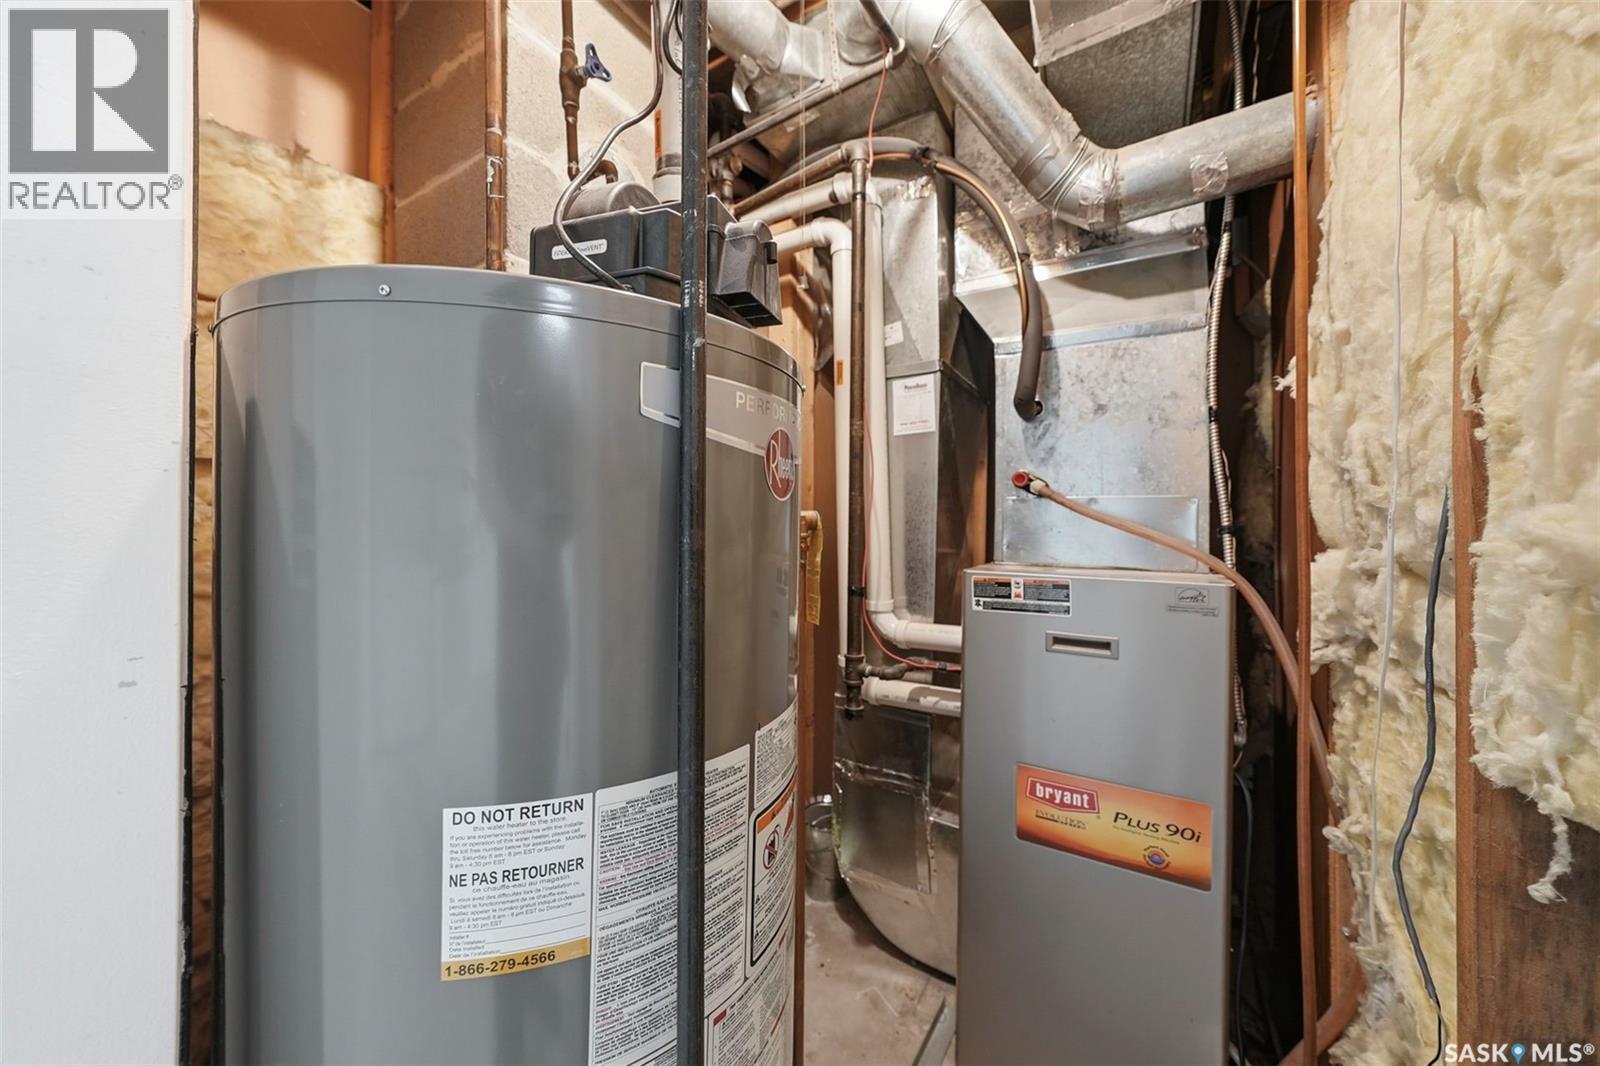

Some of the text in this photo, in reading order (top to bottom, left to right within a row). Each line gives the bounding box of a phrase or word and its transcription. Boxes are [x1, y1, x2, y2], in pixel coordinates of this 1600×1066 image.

[1036, 782, 1090, 808] bryant
[452, 811, 476, 826] DO
[481, 808, 515, 824] NOT
[519, 798, 584, 820] RETURN
[1113, 811, 1201, 843] PLUS 90i
[449, 857, 584, 888] NE PAS RETOURNER
[445, 950, 556, 977] 1-866-279-4566
